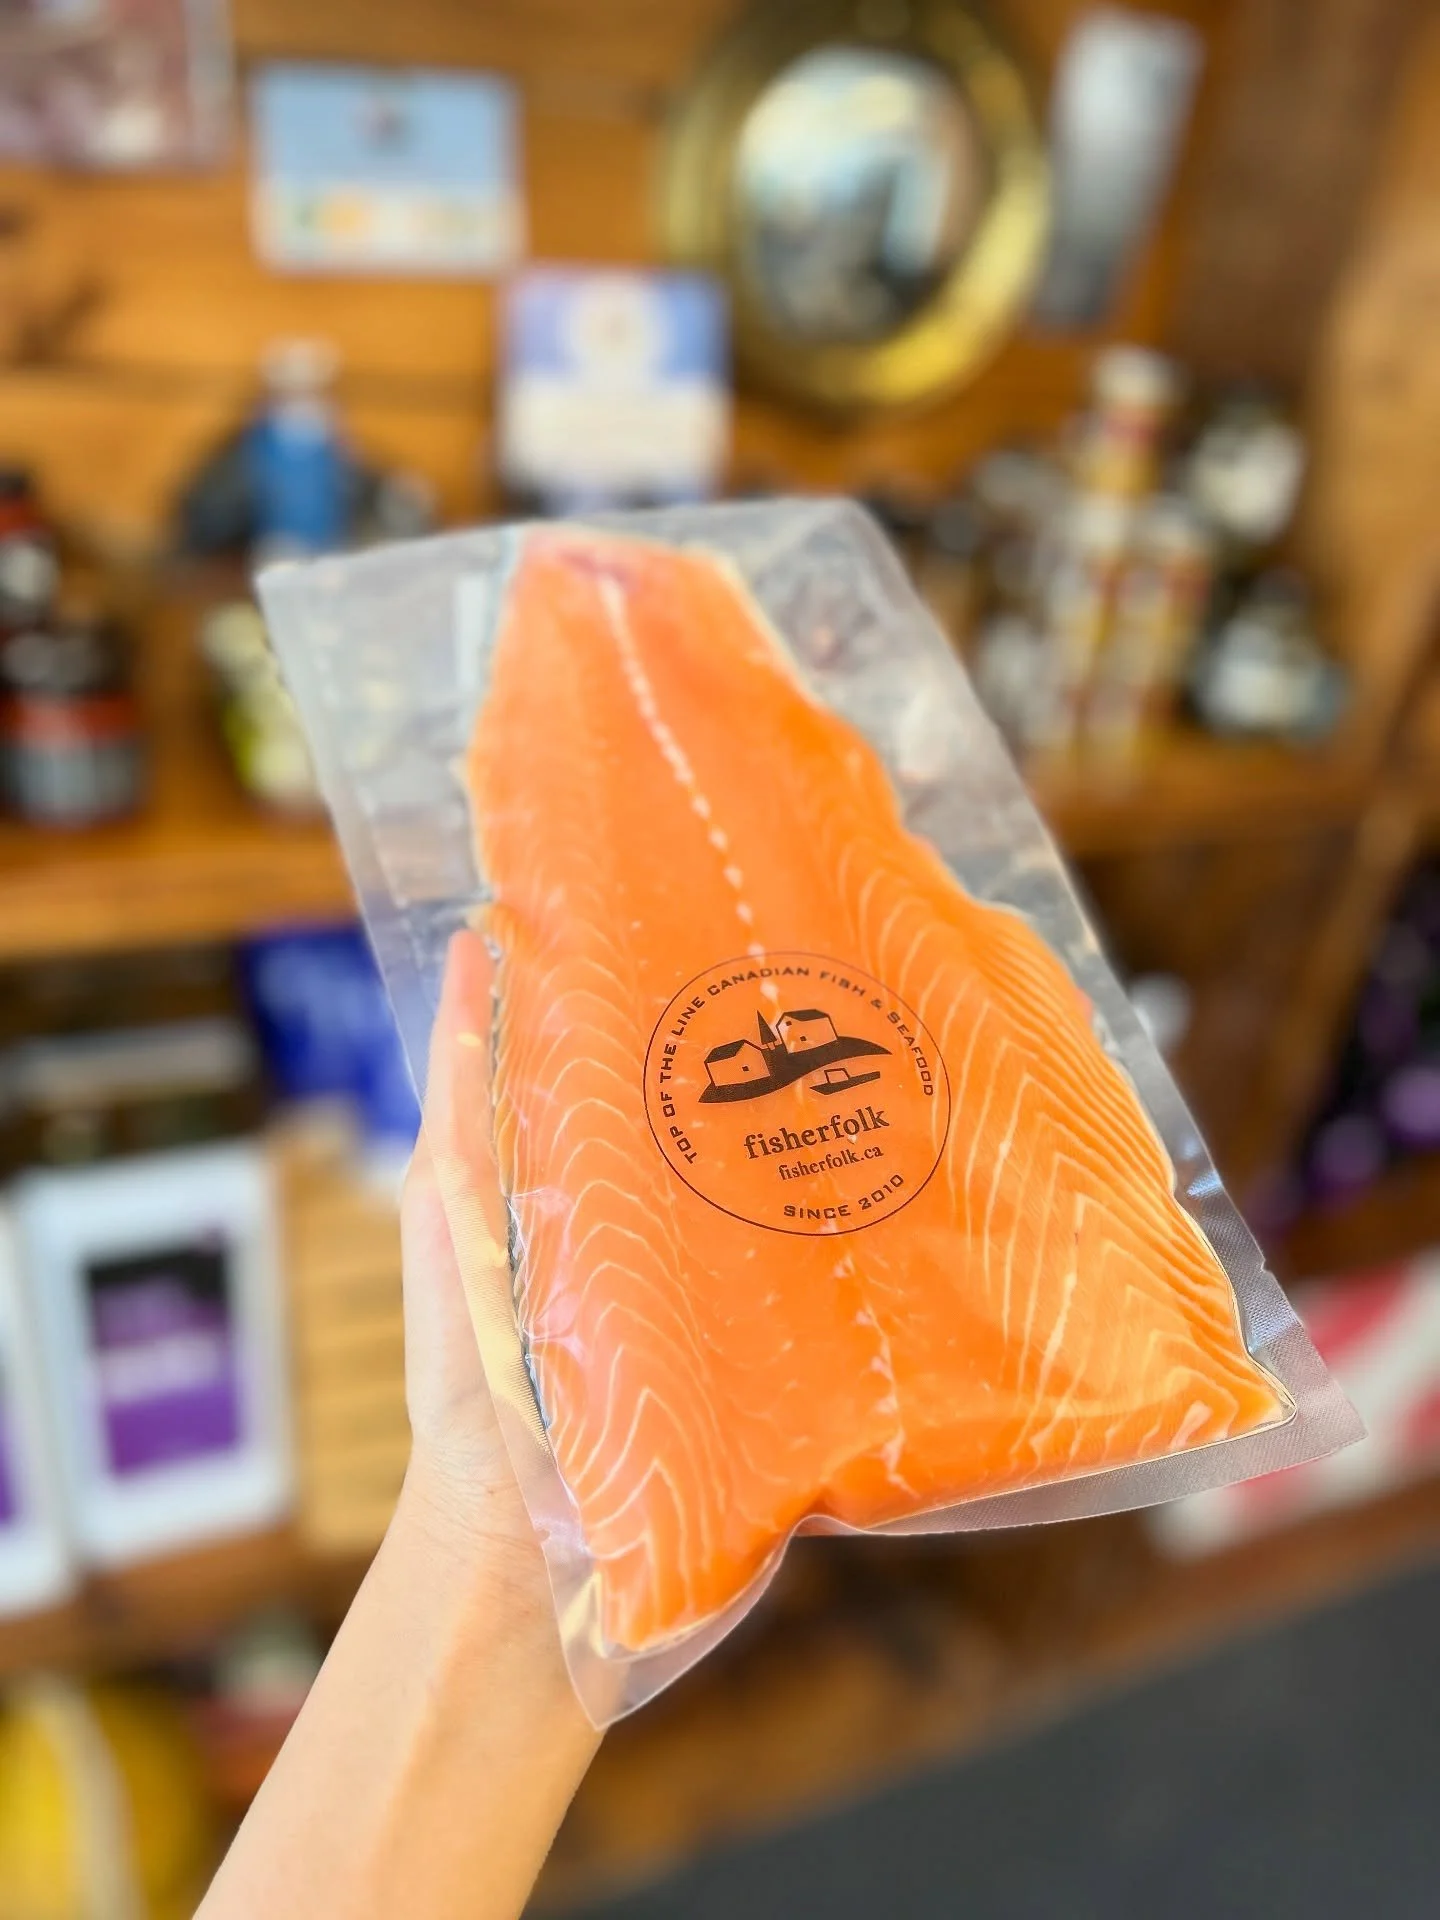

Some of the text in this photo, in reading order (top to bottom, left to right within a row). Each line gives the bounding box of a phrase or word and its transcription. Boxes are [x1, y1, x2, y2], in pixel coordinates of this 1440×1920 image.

[660, 967, 934, 1165] TOP OF THE LINE CANADIAN FISH & SEAFOOD
[743, 1105, 890, 1160] fisherfolk
[778, 1143, 884, 1182] fisherfolk.ca
[783, 1174, 904, 1220] SINCE 2010
